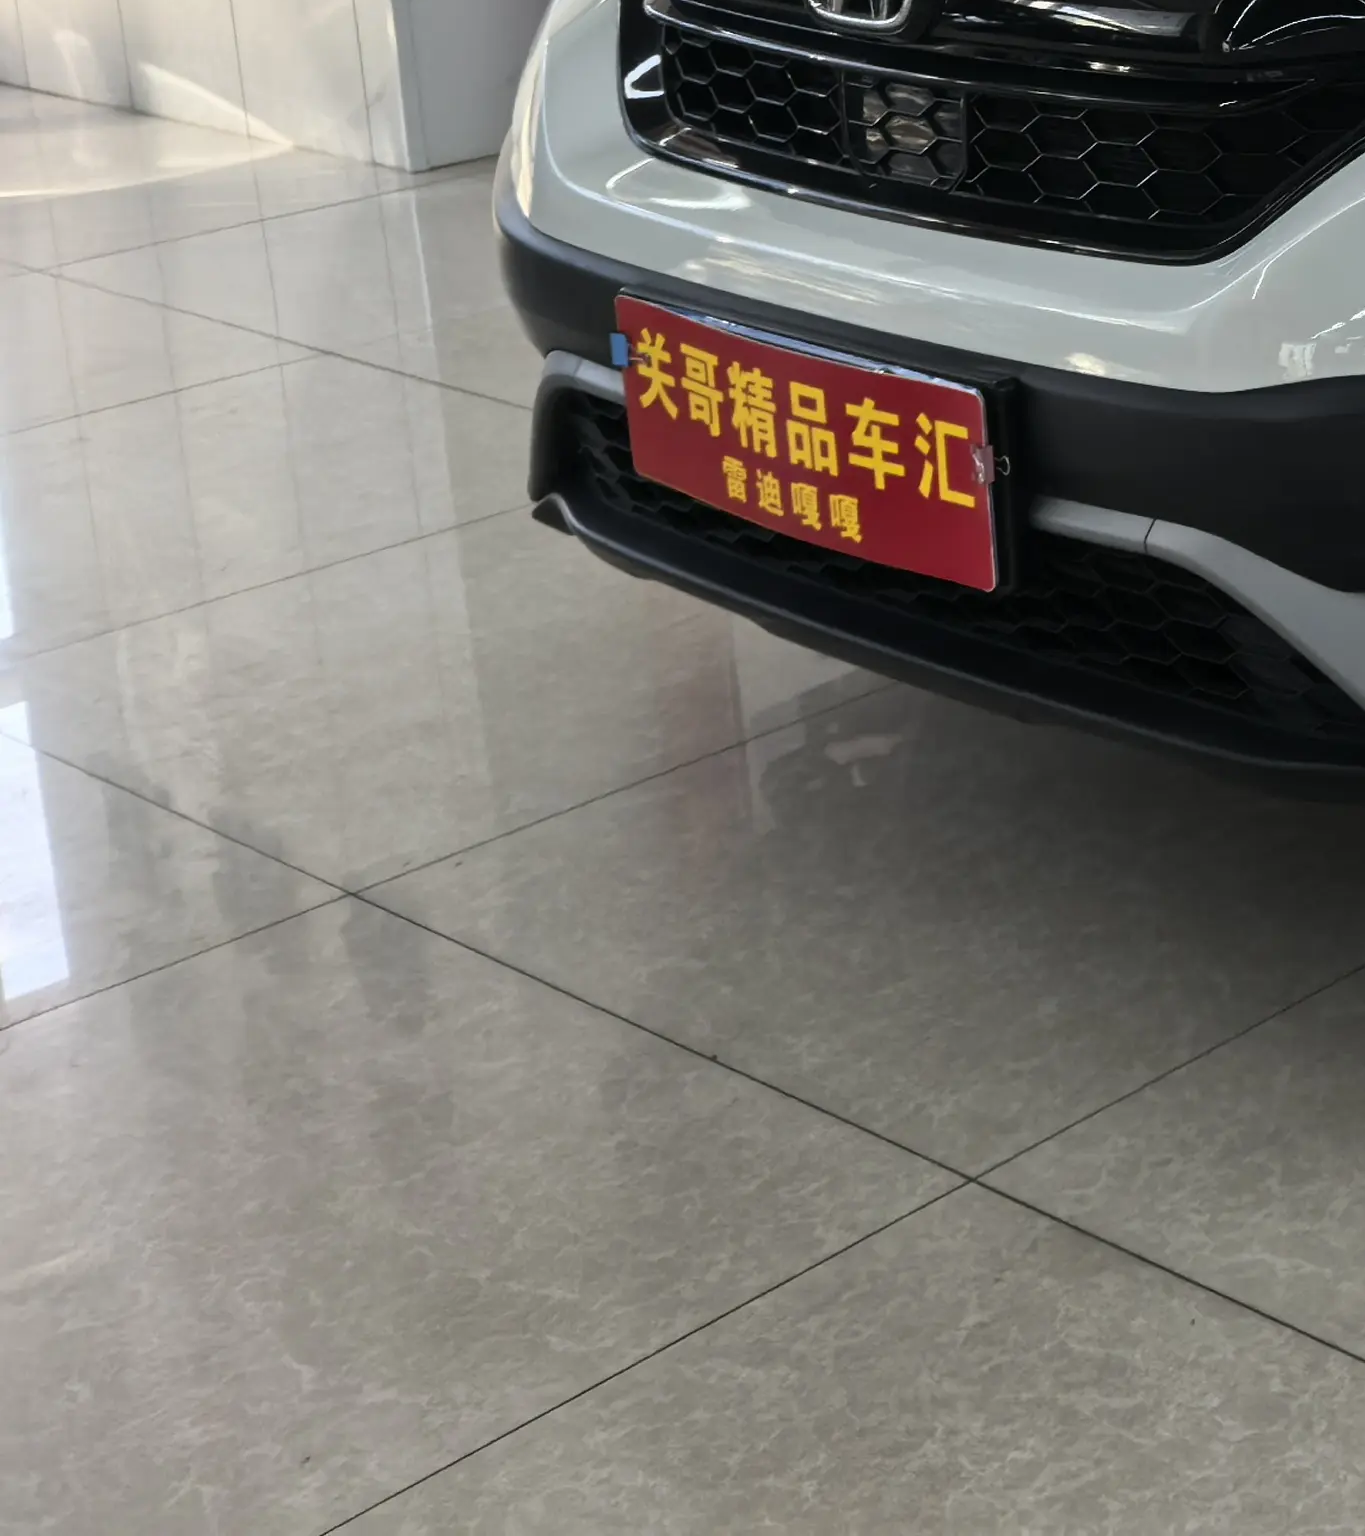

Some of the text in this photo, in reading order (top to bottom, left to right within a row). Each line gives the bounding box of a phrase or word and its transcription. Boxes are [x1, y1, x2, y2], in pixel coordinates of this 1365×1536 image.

[635, 327, 977, 509] 关哥精品车汇
